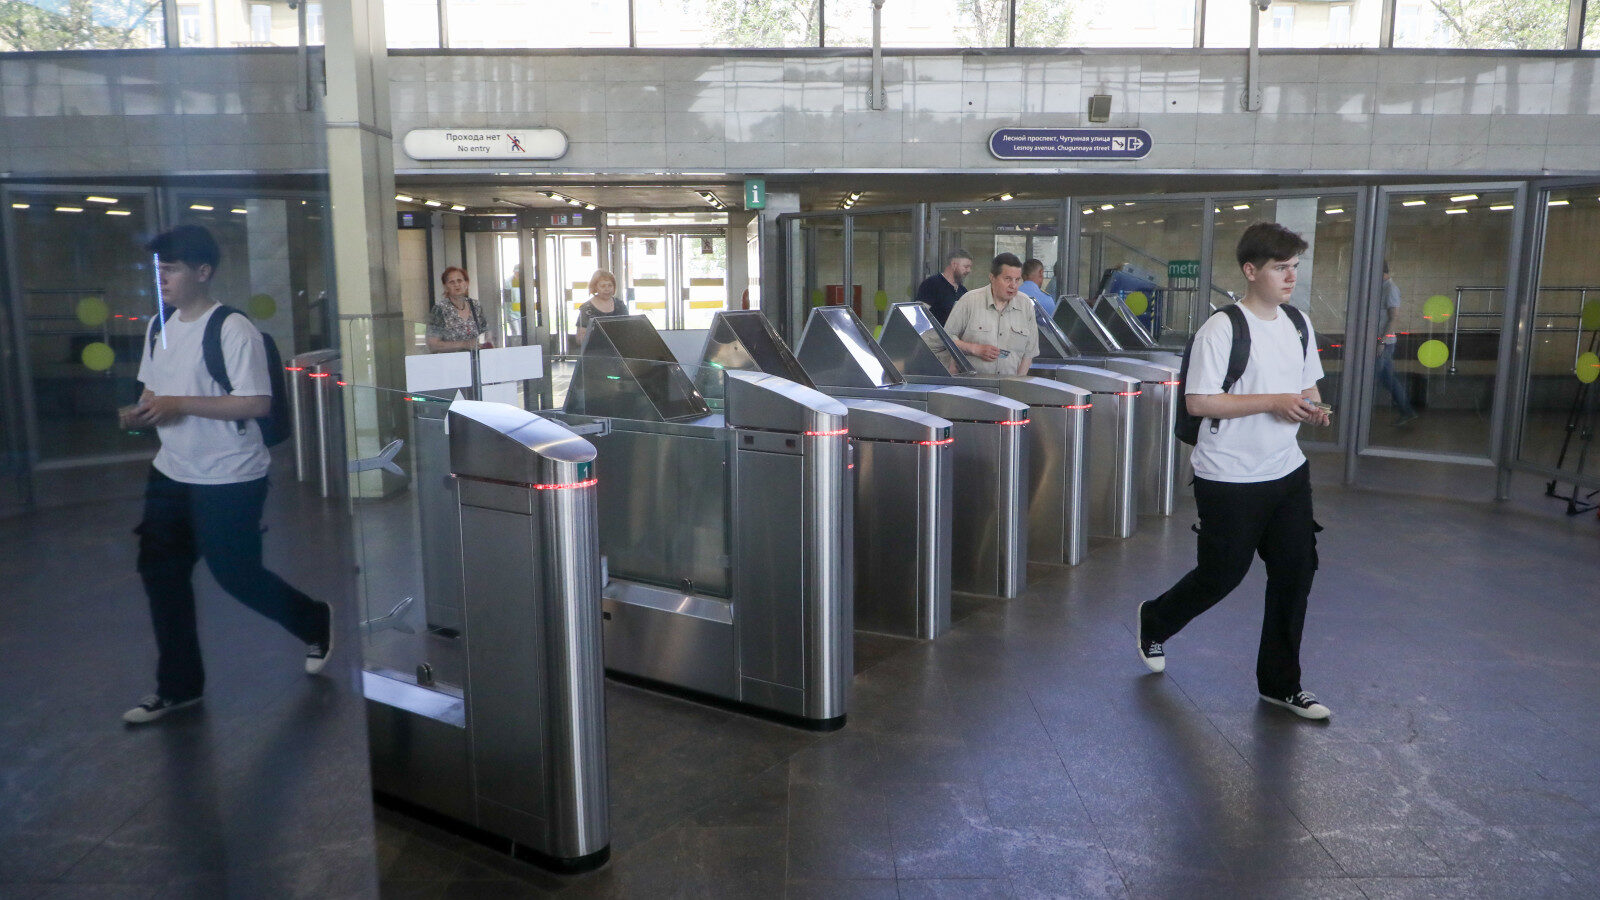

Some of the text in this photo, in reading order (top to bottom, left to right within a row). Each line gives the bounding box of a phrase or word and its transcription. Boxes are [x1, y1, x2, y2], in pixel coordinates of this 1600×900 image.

[446, 133, 484, 141] Прохода
[752, 184, 760, 203] i
[1169, 263, 1200, 274] metr
[583, 466, 588, 478] 1
